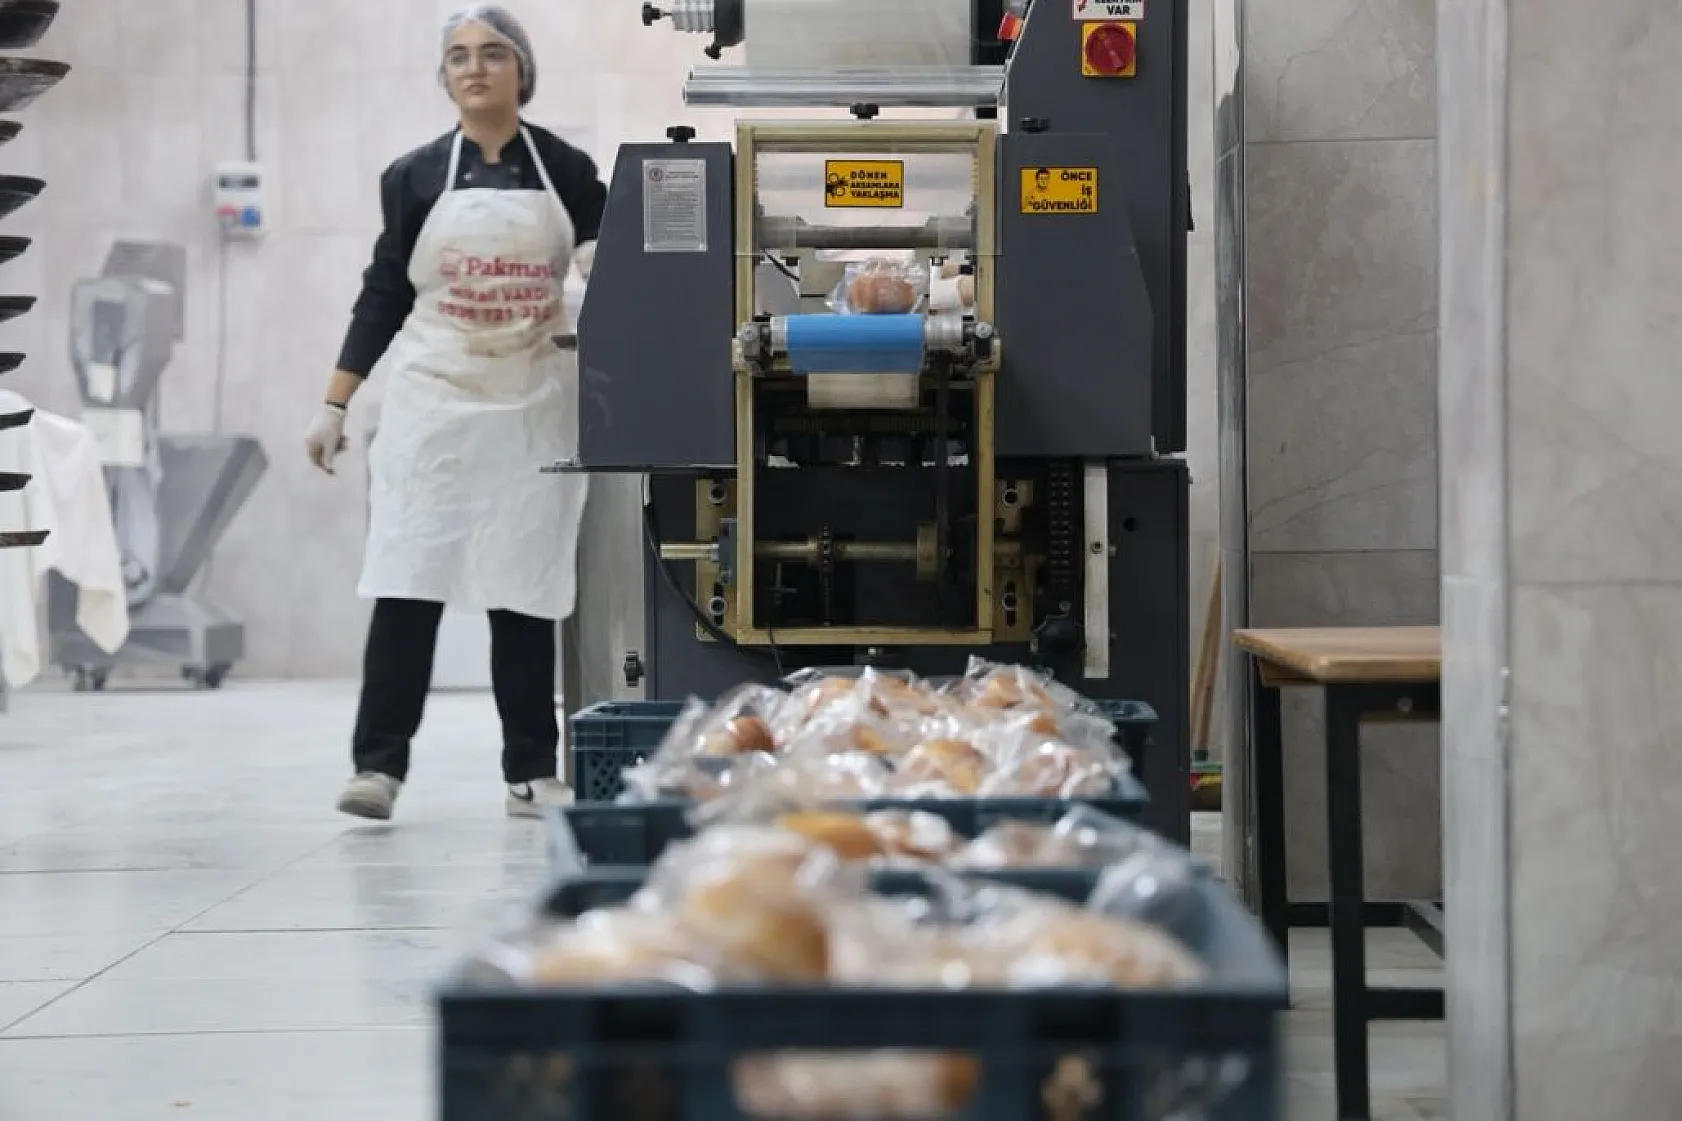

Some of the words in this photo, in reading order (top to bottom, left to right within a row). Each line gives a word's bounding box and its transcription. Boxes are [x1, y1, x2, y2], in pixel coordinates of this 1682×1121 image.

[1106, 5, 1131, 15] VAR
[850, 169, 887, 179] DÖNEN
[1061, 170, 1093, 181] ÖNCE
[850, 190, 900, 201] YAKLAŞMA
[1081, 184, 1093, 196] İŞ
[1032, 198, 1093, 210] GÜVENLİĞİ
[464, 256, 554, 279] Pakmay
